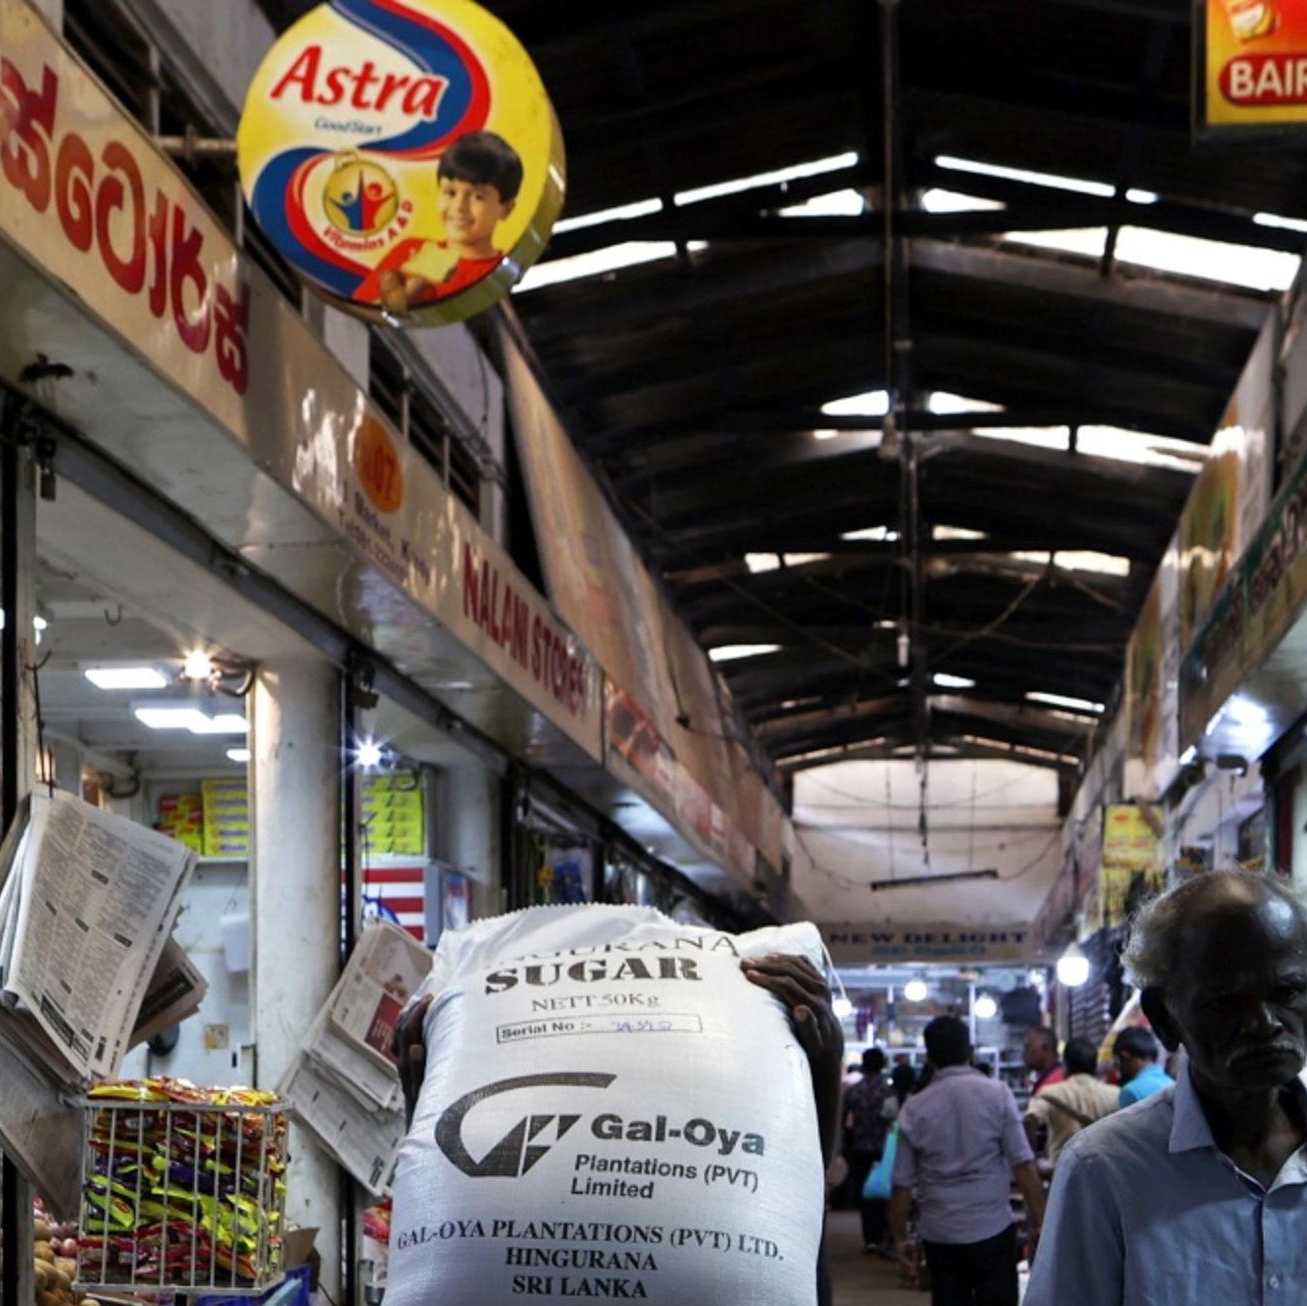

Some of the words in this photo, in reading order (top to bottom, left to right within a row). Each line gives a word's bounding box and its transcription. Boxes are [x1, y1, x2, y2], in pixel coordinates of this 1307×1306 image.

[269, 45, 445, 117] Astra
[829, 932, 894, 945] NEW
[904, 931, 1027, 944] DELIGHT
[485, 957, 703, 996] SUGAR
[531, 996, 598, 1013] NETT
[599, 993, 661, 1008] 50Kg
[501, 1024, 546, 1039] Serial
[551, 1022, 575, 1032] No
[590, 1113, 766, 1156] Gal-Oya
[574, 1154, 698, 1179] Plantations
[703, 1164, 759, 1193] (PVT)
[571, 1177, 655, 1199] Limited
[398, 1219, 486, 1250] GAL-OYA
[492, 1221, 663, 1245] PLANTATIONS
[670, 1227, 731, 1253] (PVT)
[739, 1234, 785, 1261] LTD.
[505, 1246, 658, 1271] HINGURANA
[512, 1276, 556, 1296] SRI
[560, 1279, 647, 1299] LANKA
